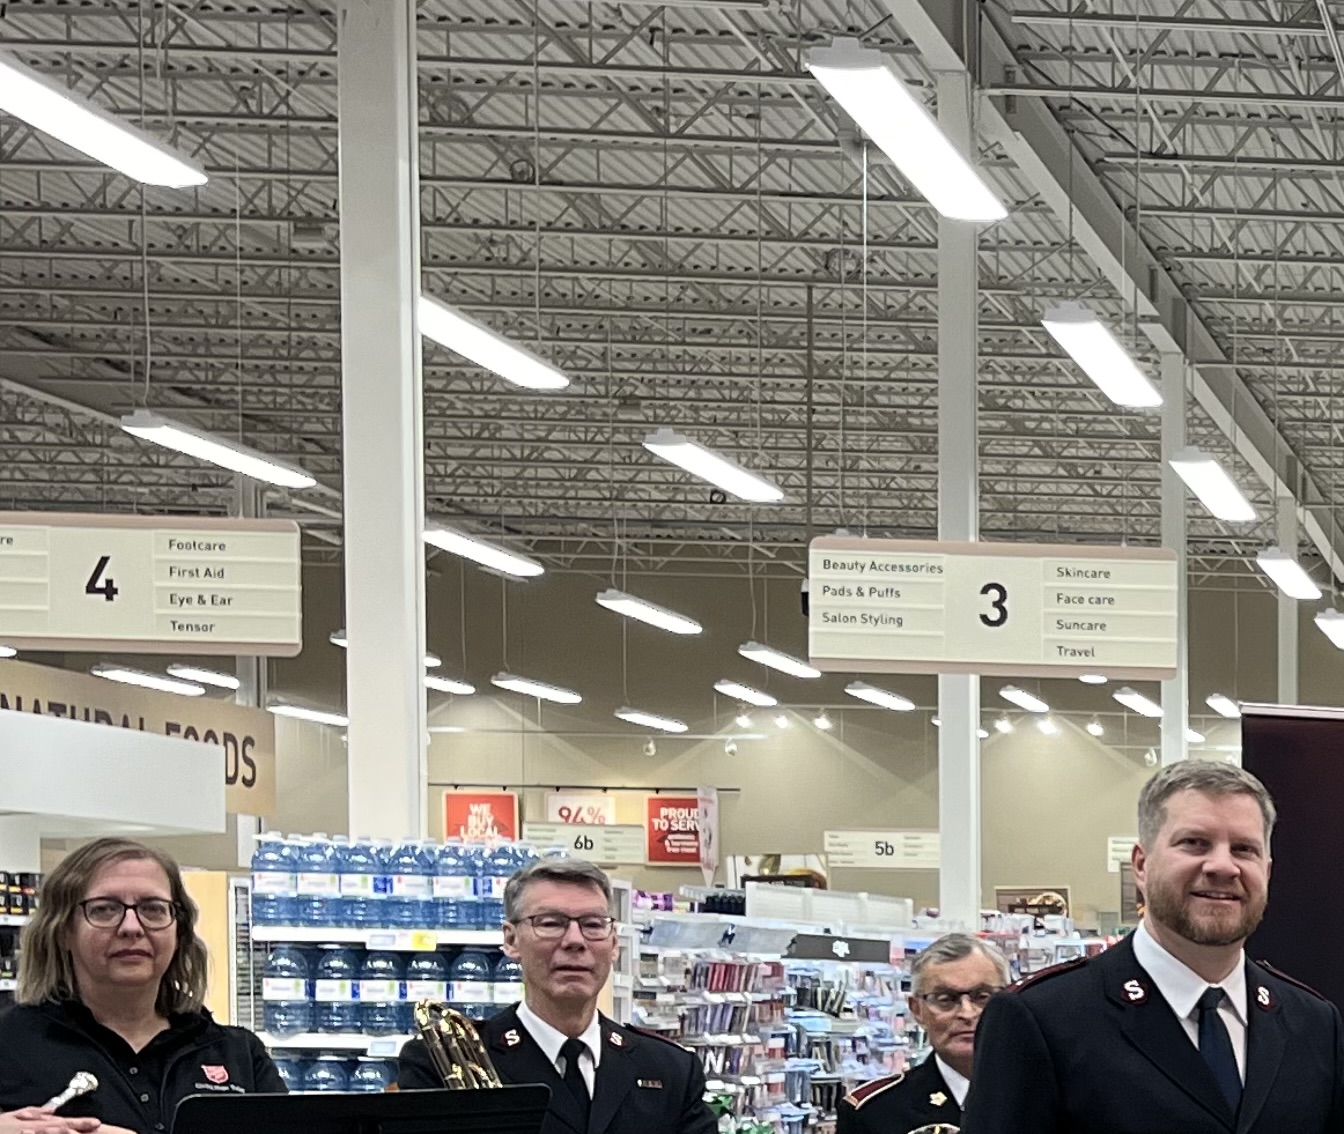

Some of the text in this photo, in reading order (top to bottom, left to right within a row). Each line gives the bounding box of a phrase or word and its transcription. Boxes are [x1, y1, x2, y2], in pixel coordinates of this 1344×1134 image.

[169, 540, 227, 554] Footcare
[169, 567, 225, 583] First Aid
[823, 559, 943, 575] Beauty Accessories
[1056, 567, 1111, 580] Skincare
[85, 556, 118, 601] 4
[170, 594, 233, 607] Eye & Ear
[823, 586, 901, 599] Pads & Puffs
[1057, 593, 1115, 606] Face care
[979, 582, 1008, 627] 3
[170, 620, 216, 636] Tensor
[823, 612, 904, 628] Salon Styling
[1057, 619, 1107, 632] Suncare
[1057, 646, 1096, 658] Travel
[652, 818, 669, 831] TO
[574, 835, 594, 851] 6b
[875, 840, 894, 856] 5b
[1124, 980, 1145, 1000] S
[504, 1029, 521, 1047] S
